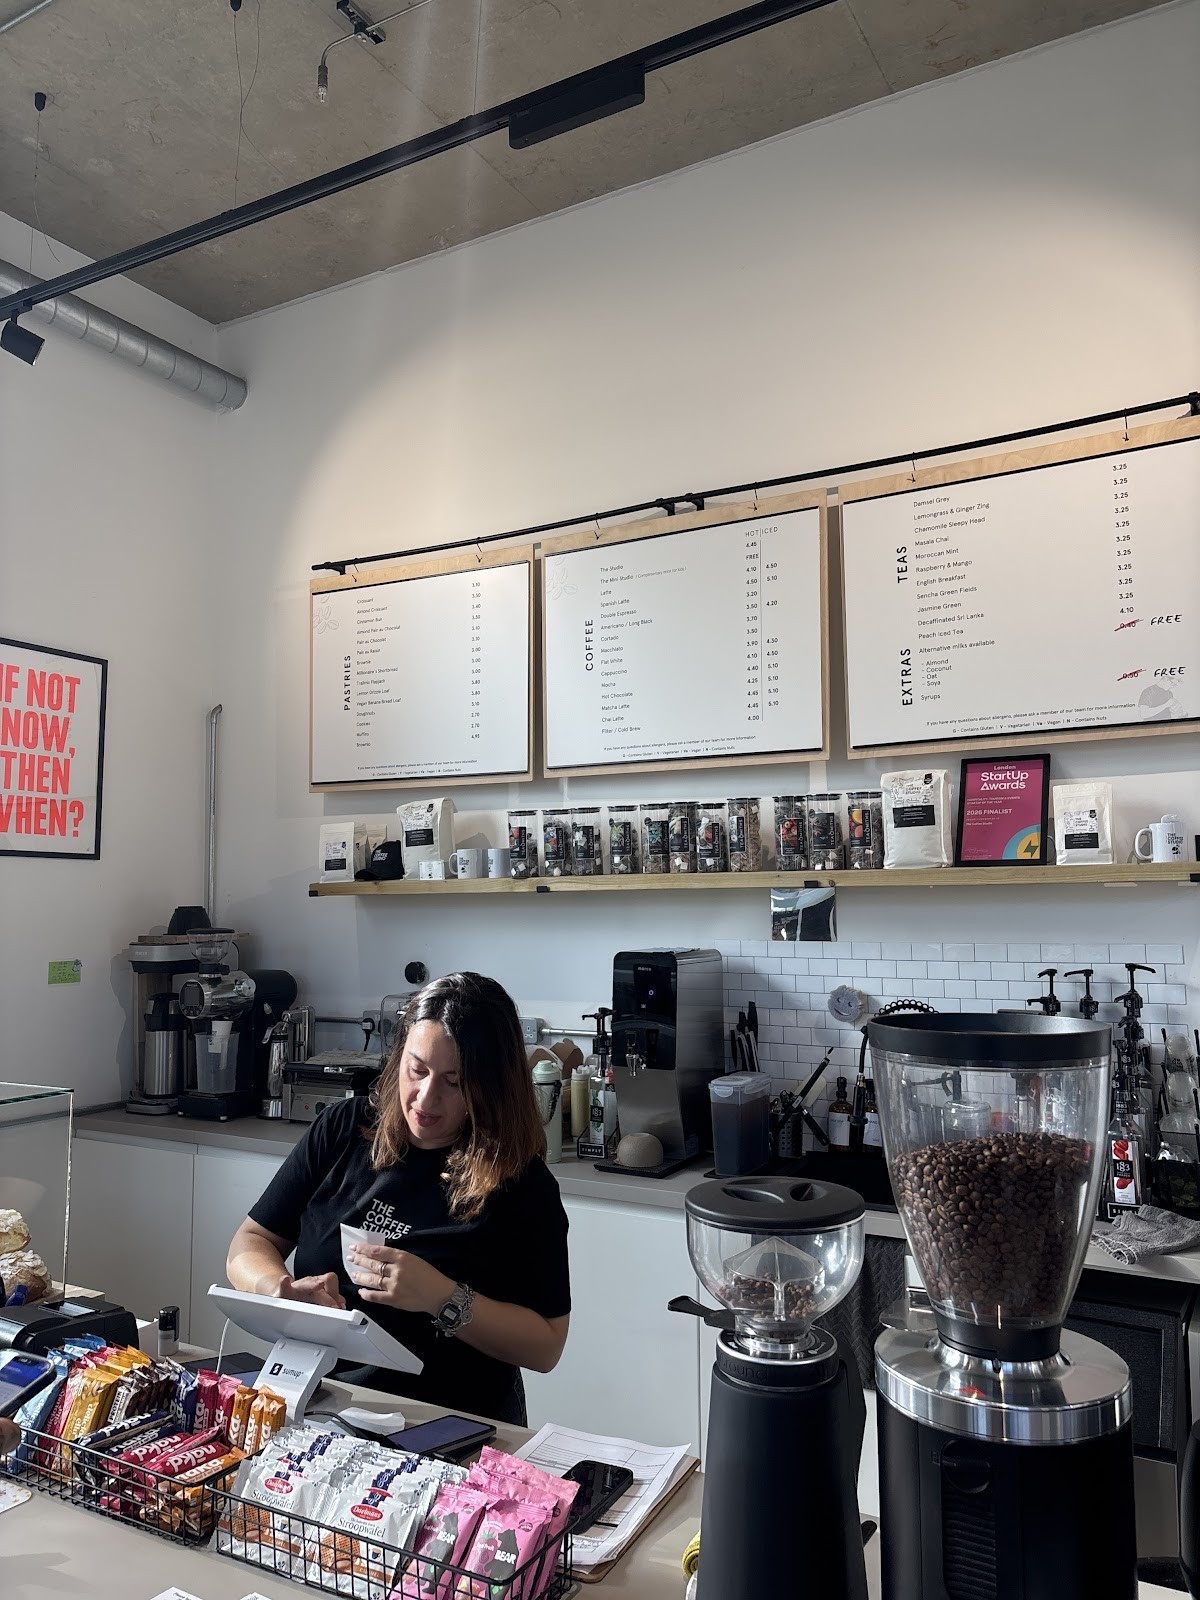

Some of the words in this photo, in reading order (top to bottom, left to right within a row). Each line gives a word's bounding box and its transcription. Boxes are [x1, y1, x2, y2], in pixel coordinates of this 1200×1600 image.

[1112, 463, 1127, 471] 3.25
[1113, 477, 1127, 485] 3.25
[1114, 491, 1128, 499] 3.25
[913, 510, 949, 520] Lemongrass
[955, 505, 975, 513] Ginger
[914, 523, 947, 533] Chamomile
[969, 516, 985, 524] Head
[1115, 520, 1130, 528] 3.25
[1116, 534, 1130, 542] 3.25
[915, 551, 944, 559] Moroccan
[1117, 548, 1131, 556] 3.25
[897, 546, 908, 583] TEAS
[916, 578, 936, 586] English
[938, 573, 966, 583] Breakfast
[1118, 577, 1132, 585] 3.25
[916, 591, 938, 599] Sencha
[939, 589, 958, 597] Green
[917, 605, 941, 613] Jasmine
[1150, 615, 1182, 625] FREE
[918, 631, 936, 639] Peach
[585, 620, 594, 672] COFFEE
[918, 645, 951, 653] Alternative
[968, 639, 995, 647] available
[926, 665, 952, 673] Coconut
[1154, 667, 1186, 677] FREE
[901, 648, 913, 706] EXTRAS
[27, 668, 80, 713] NOT
[1, 708, 76, 759] NOW,
[0, 751, 70, 795] THEN
[981, 770, 1029, 781] StartUp
[980, 780, 1026, 790] Awards
[372, 1199, 395, 1217] THE
[366, 1211, 412, 1234] COFFEE
[109, 1391, 122, 1421] PROTEIN
[251, 1489, 295, 1510] Stroopwafel
[338, 1517, 386, 1538] Stroopwafel
[437, 1531, 456, 1544] BEAR
[495, 1550, 516, 1564] BEAR
